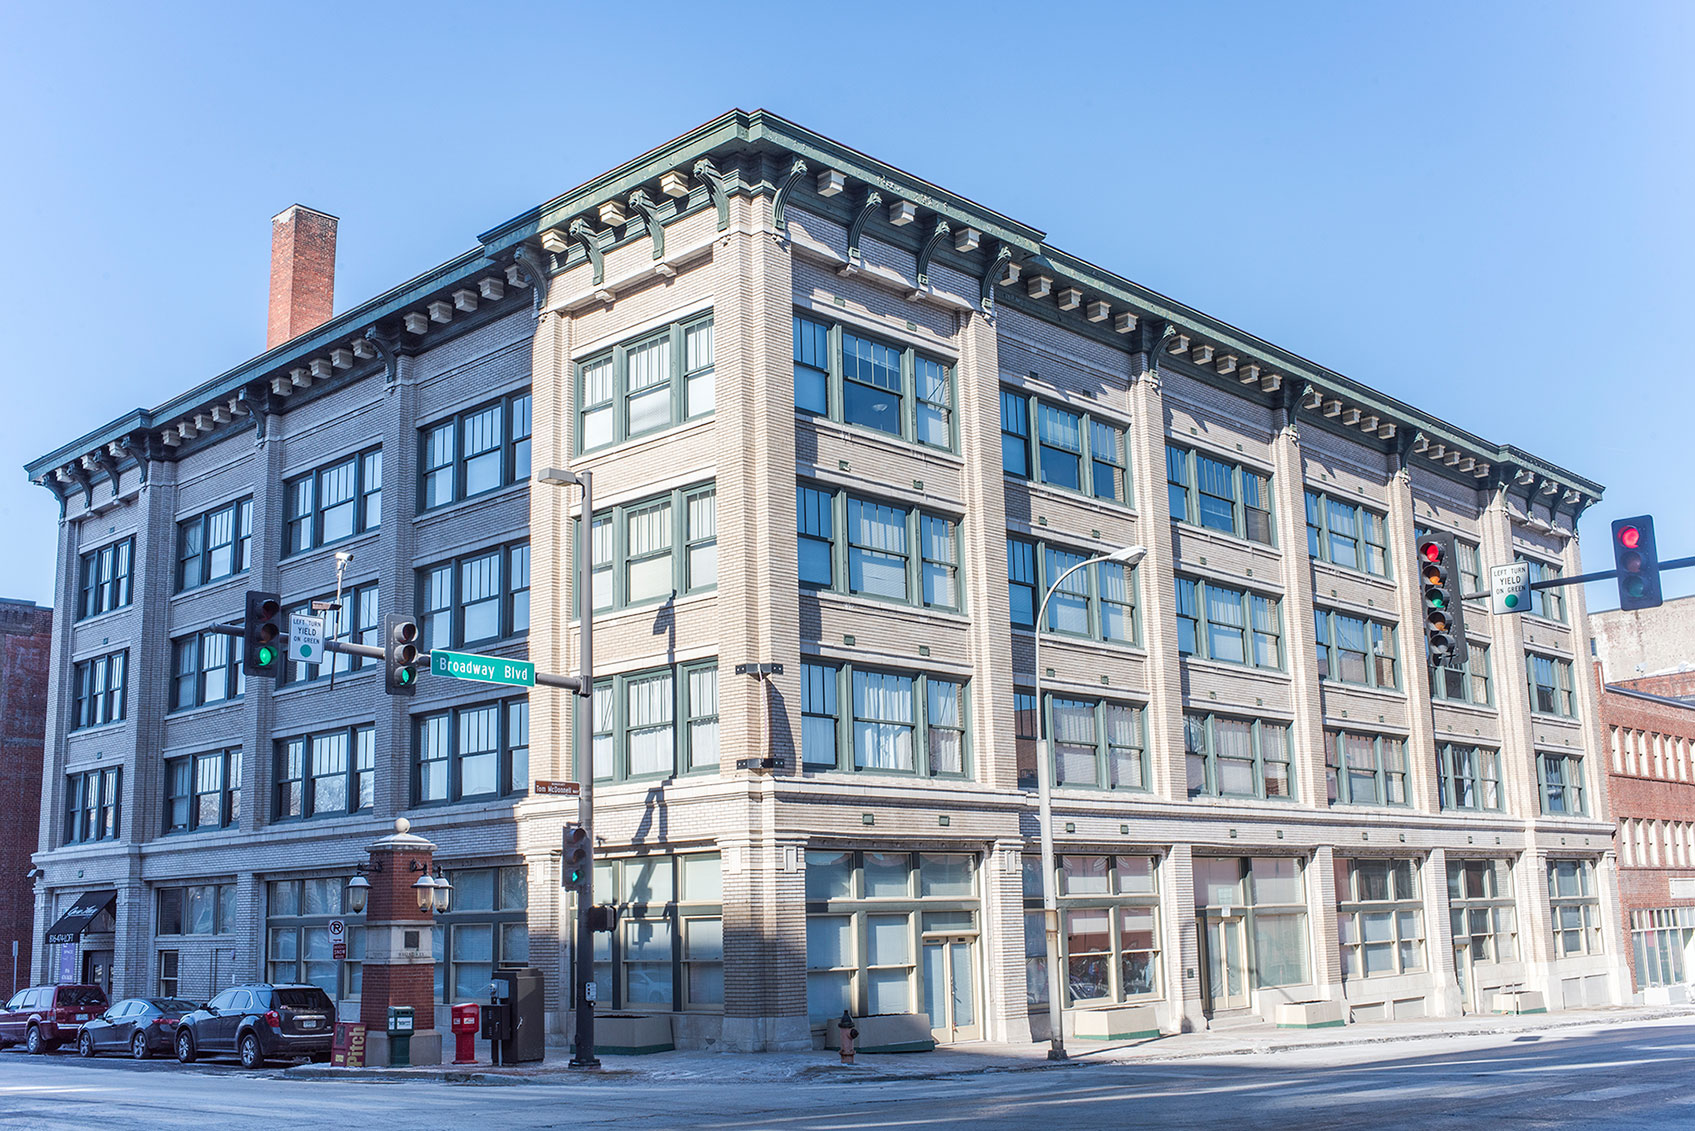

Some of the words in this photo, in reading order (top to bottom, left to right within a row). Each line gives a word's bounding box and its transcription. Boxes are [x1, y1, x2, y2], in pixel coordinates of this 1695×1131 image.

[1494, 569, 1507, 577] LEFT
[1499, 576, 1521, 585] YIELD
[1507, 585, 1526, 593] GREEN
[297, 627, 317, 636] YIELD
[439, 657, 495, 680] Broadway
[504, 665, 528, 681] Blvd
[536, 784, 547, 792] Tom
[547, 785, 571, 793] McDonnell
[346, 1026, 366, 1068] Pitch
